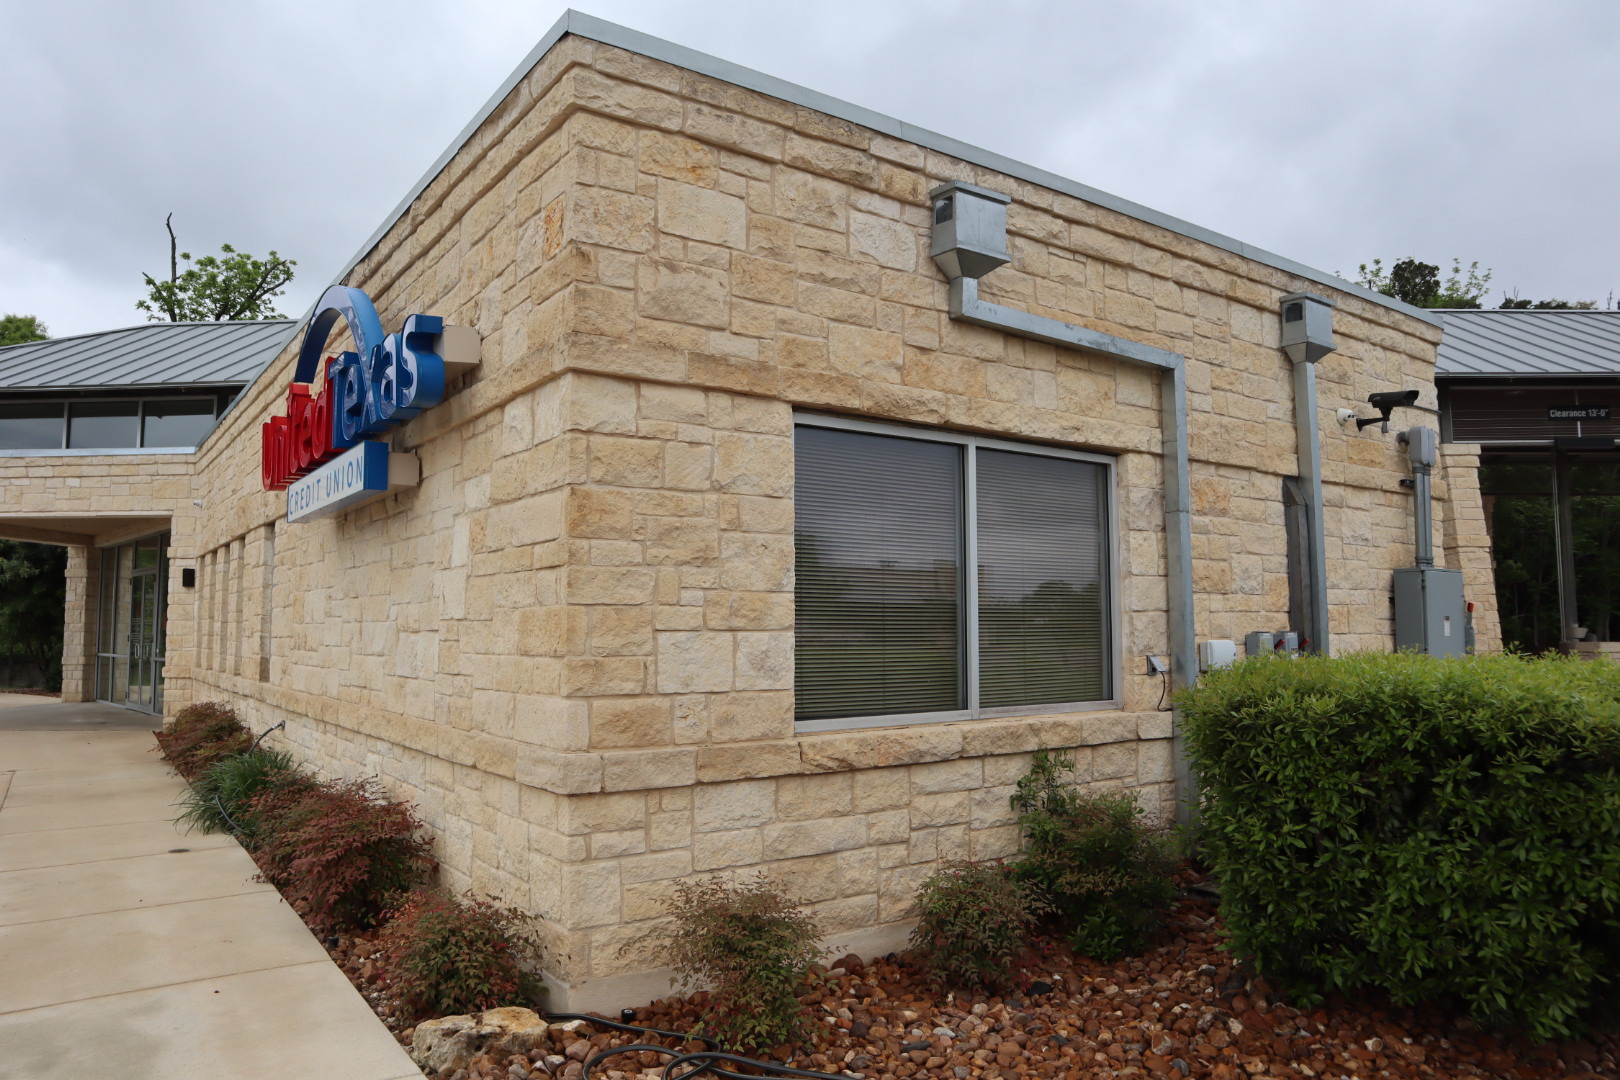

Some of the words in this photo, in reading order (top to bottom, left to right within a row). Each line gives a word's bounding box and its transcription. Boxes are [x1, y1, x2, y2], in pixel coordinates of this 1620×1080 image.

[1550, 409, 1586, 418] Clearance
[289, 478, 321, 515] CREDIT
[326, 455, 363, 498] UNION
